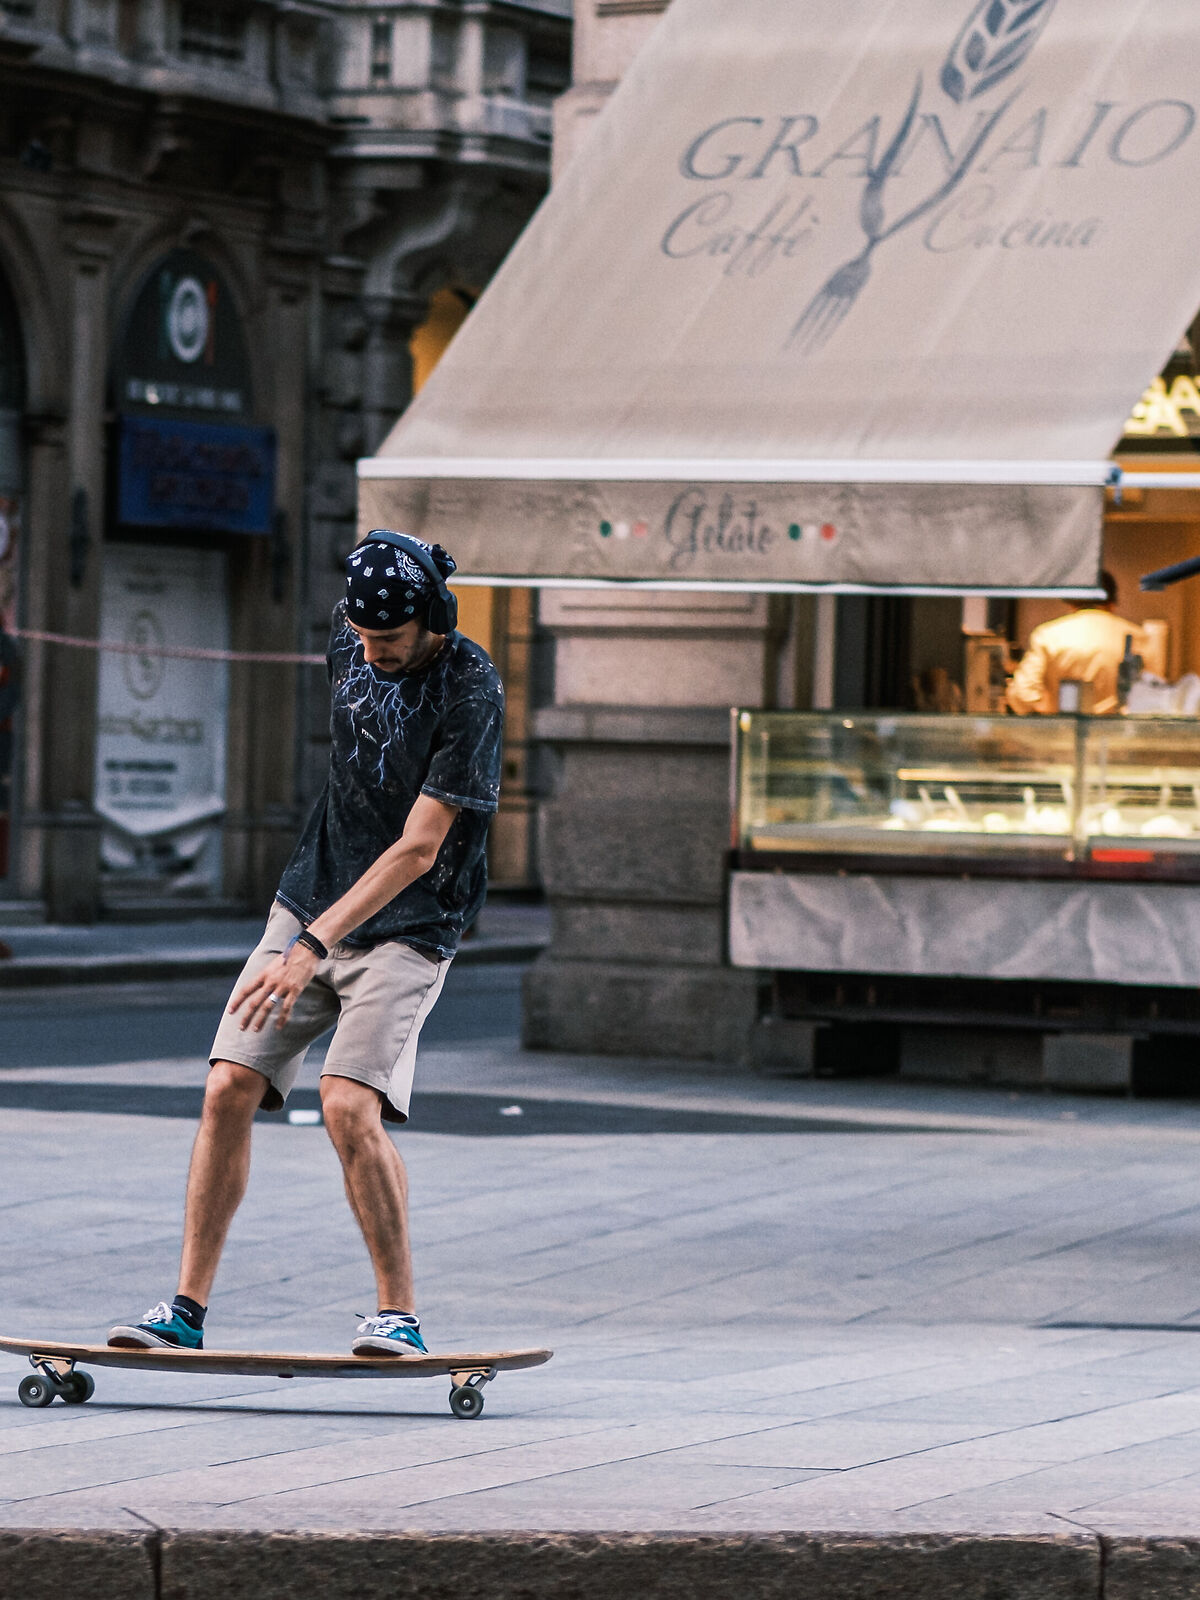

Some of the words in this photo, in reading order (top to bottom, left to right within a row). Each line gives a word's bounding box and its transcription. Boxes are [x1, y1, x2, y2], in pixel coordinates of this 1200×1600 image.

[680, 99, 1196, 180] GRANAIO
[661, 190, 819, 277] Caffè
[665, 486, 775, 568] Gelato
